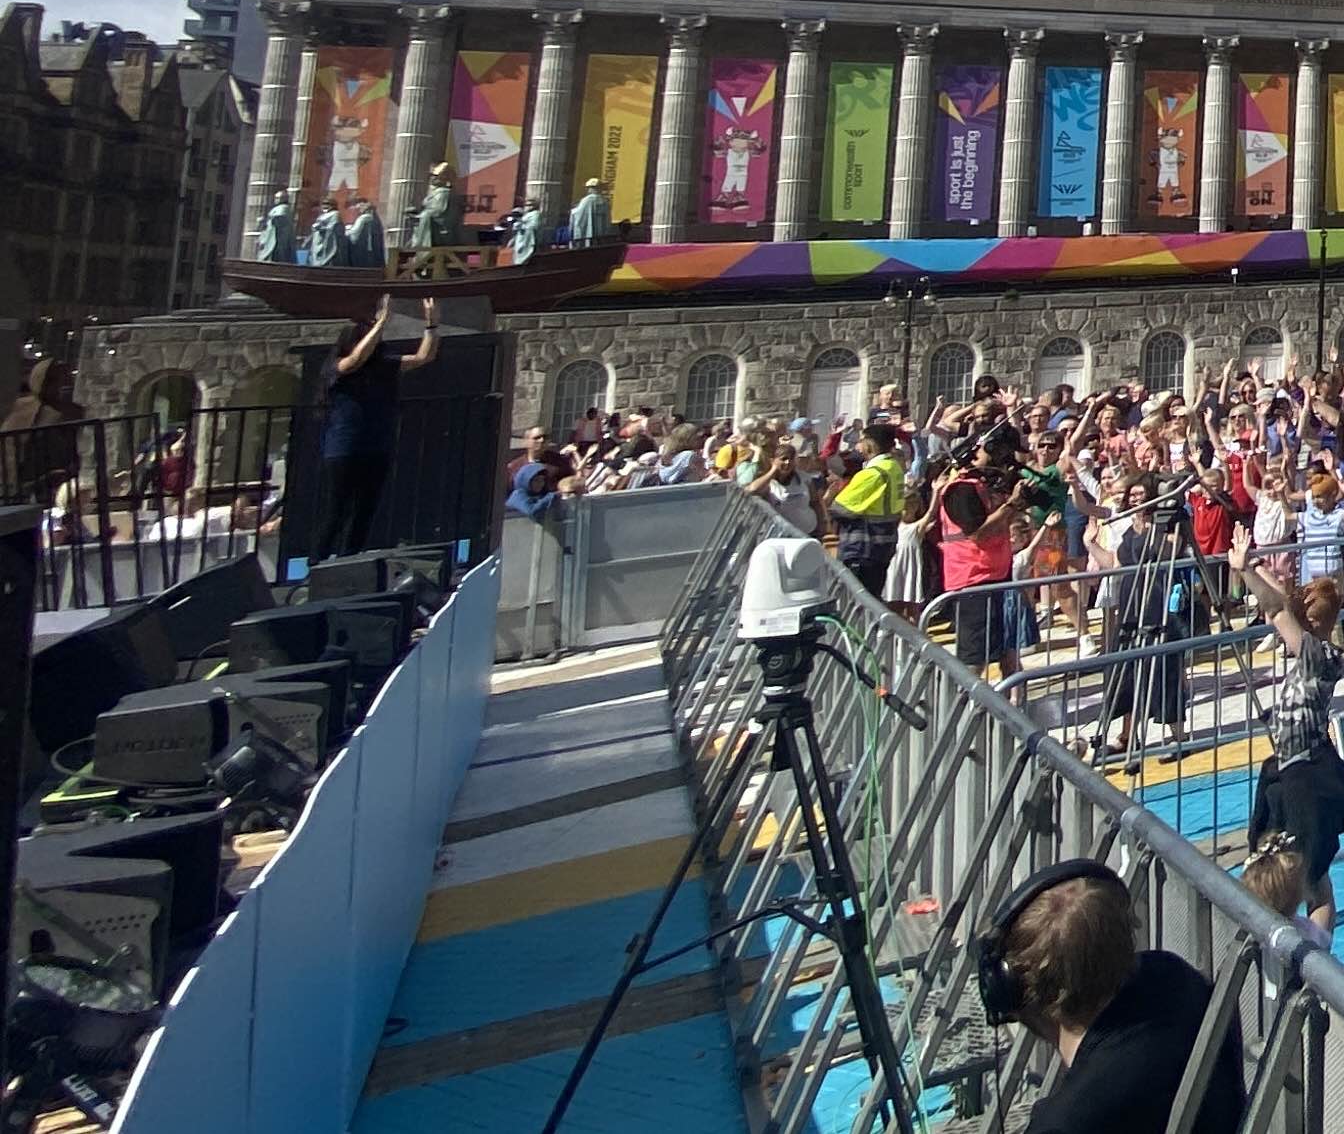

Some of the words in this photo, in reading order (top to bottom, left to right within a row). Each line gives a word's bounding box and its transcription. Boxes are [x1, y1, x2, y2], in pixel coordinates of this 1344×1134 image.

[608, 125, 623, 149] 2022
[952, 135, 966, 157] just
[951, 159, 962, 169] is
[963, 130, 981, 188] beginning
[949, 174, 962, 204] sport
[960, 191, 973, 210] the
